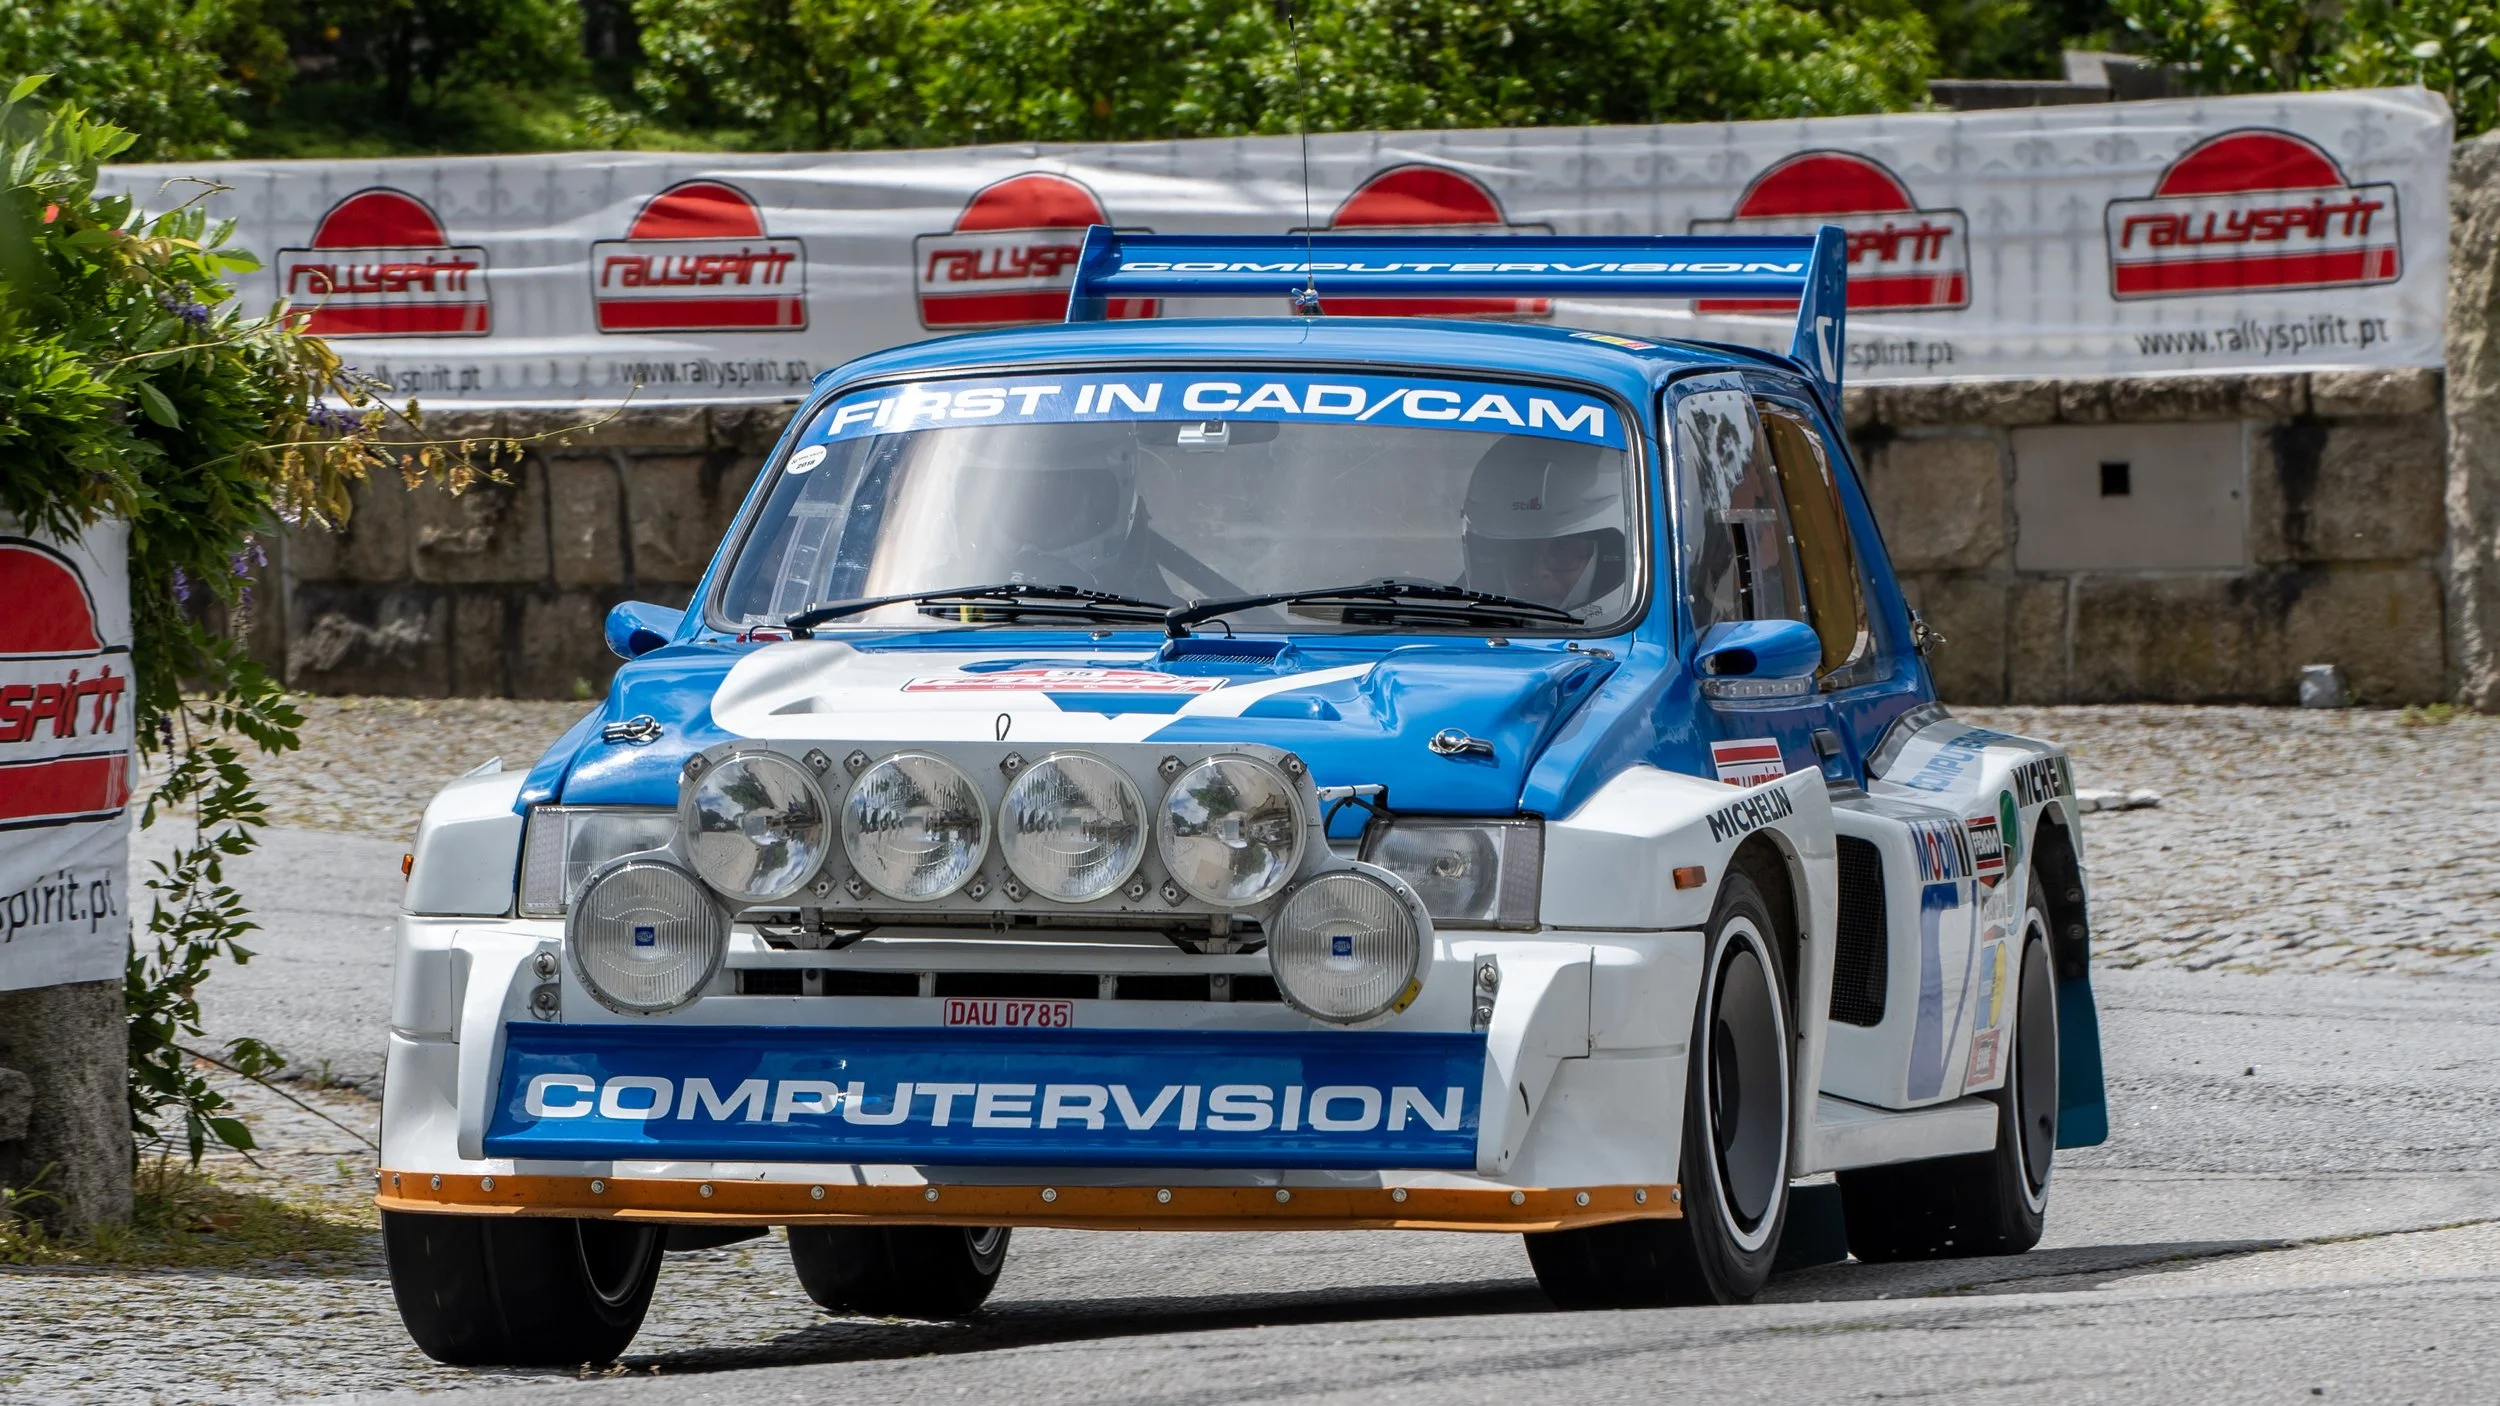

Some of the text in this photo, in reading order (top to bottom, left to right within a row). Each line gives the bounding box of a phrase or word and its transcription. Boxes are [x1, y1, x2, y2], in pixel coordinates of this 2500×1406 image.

[2121, 196, 2383, 249] rallyspirit
[601, 247, 795, 287] rallyspirit
[1120, 263, 1804, 273] COMPUTERVISION
[2133, 315, 2391, 356] www.rallyspirit.pt
[827, 382, 1605, 440] FIRST IN CAD/CAM
[1706, 787, 1793, 843] MICHELIN
[950, 1002, 1068, 1028] DAU 0785
[526, 1073, 1464, 1132] COMPUTERVISION
